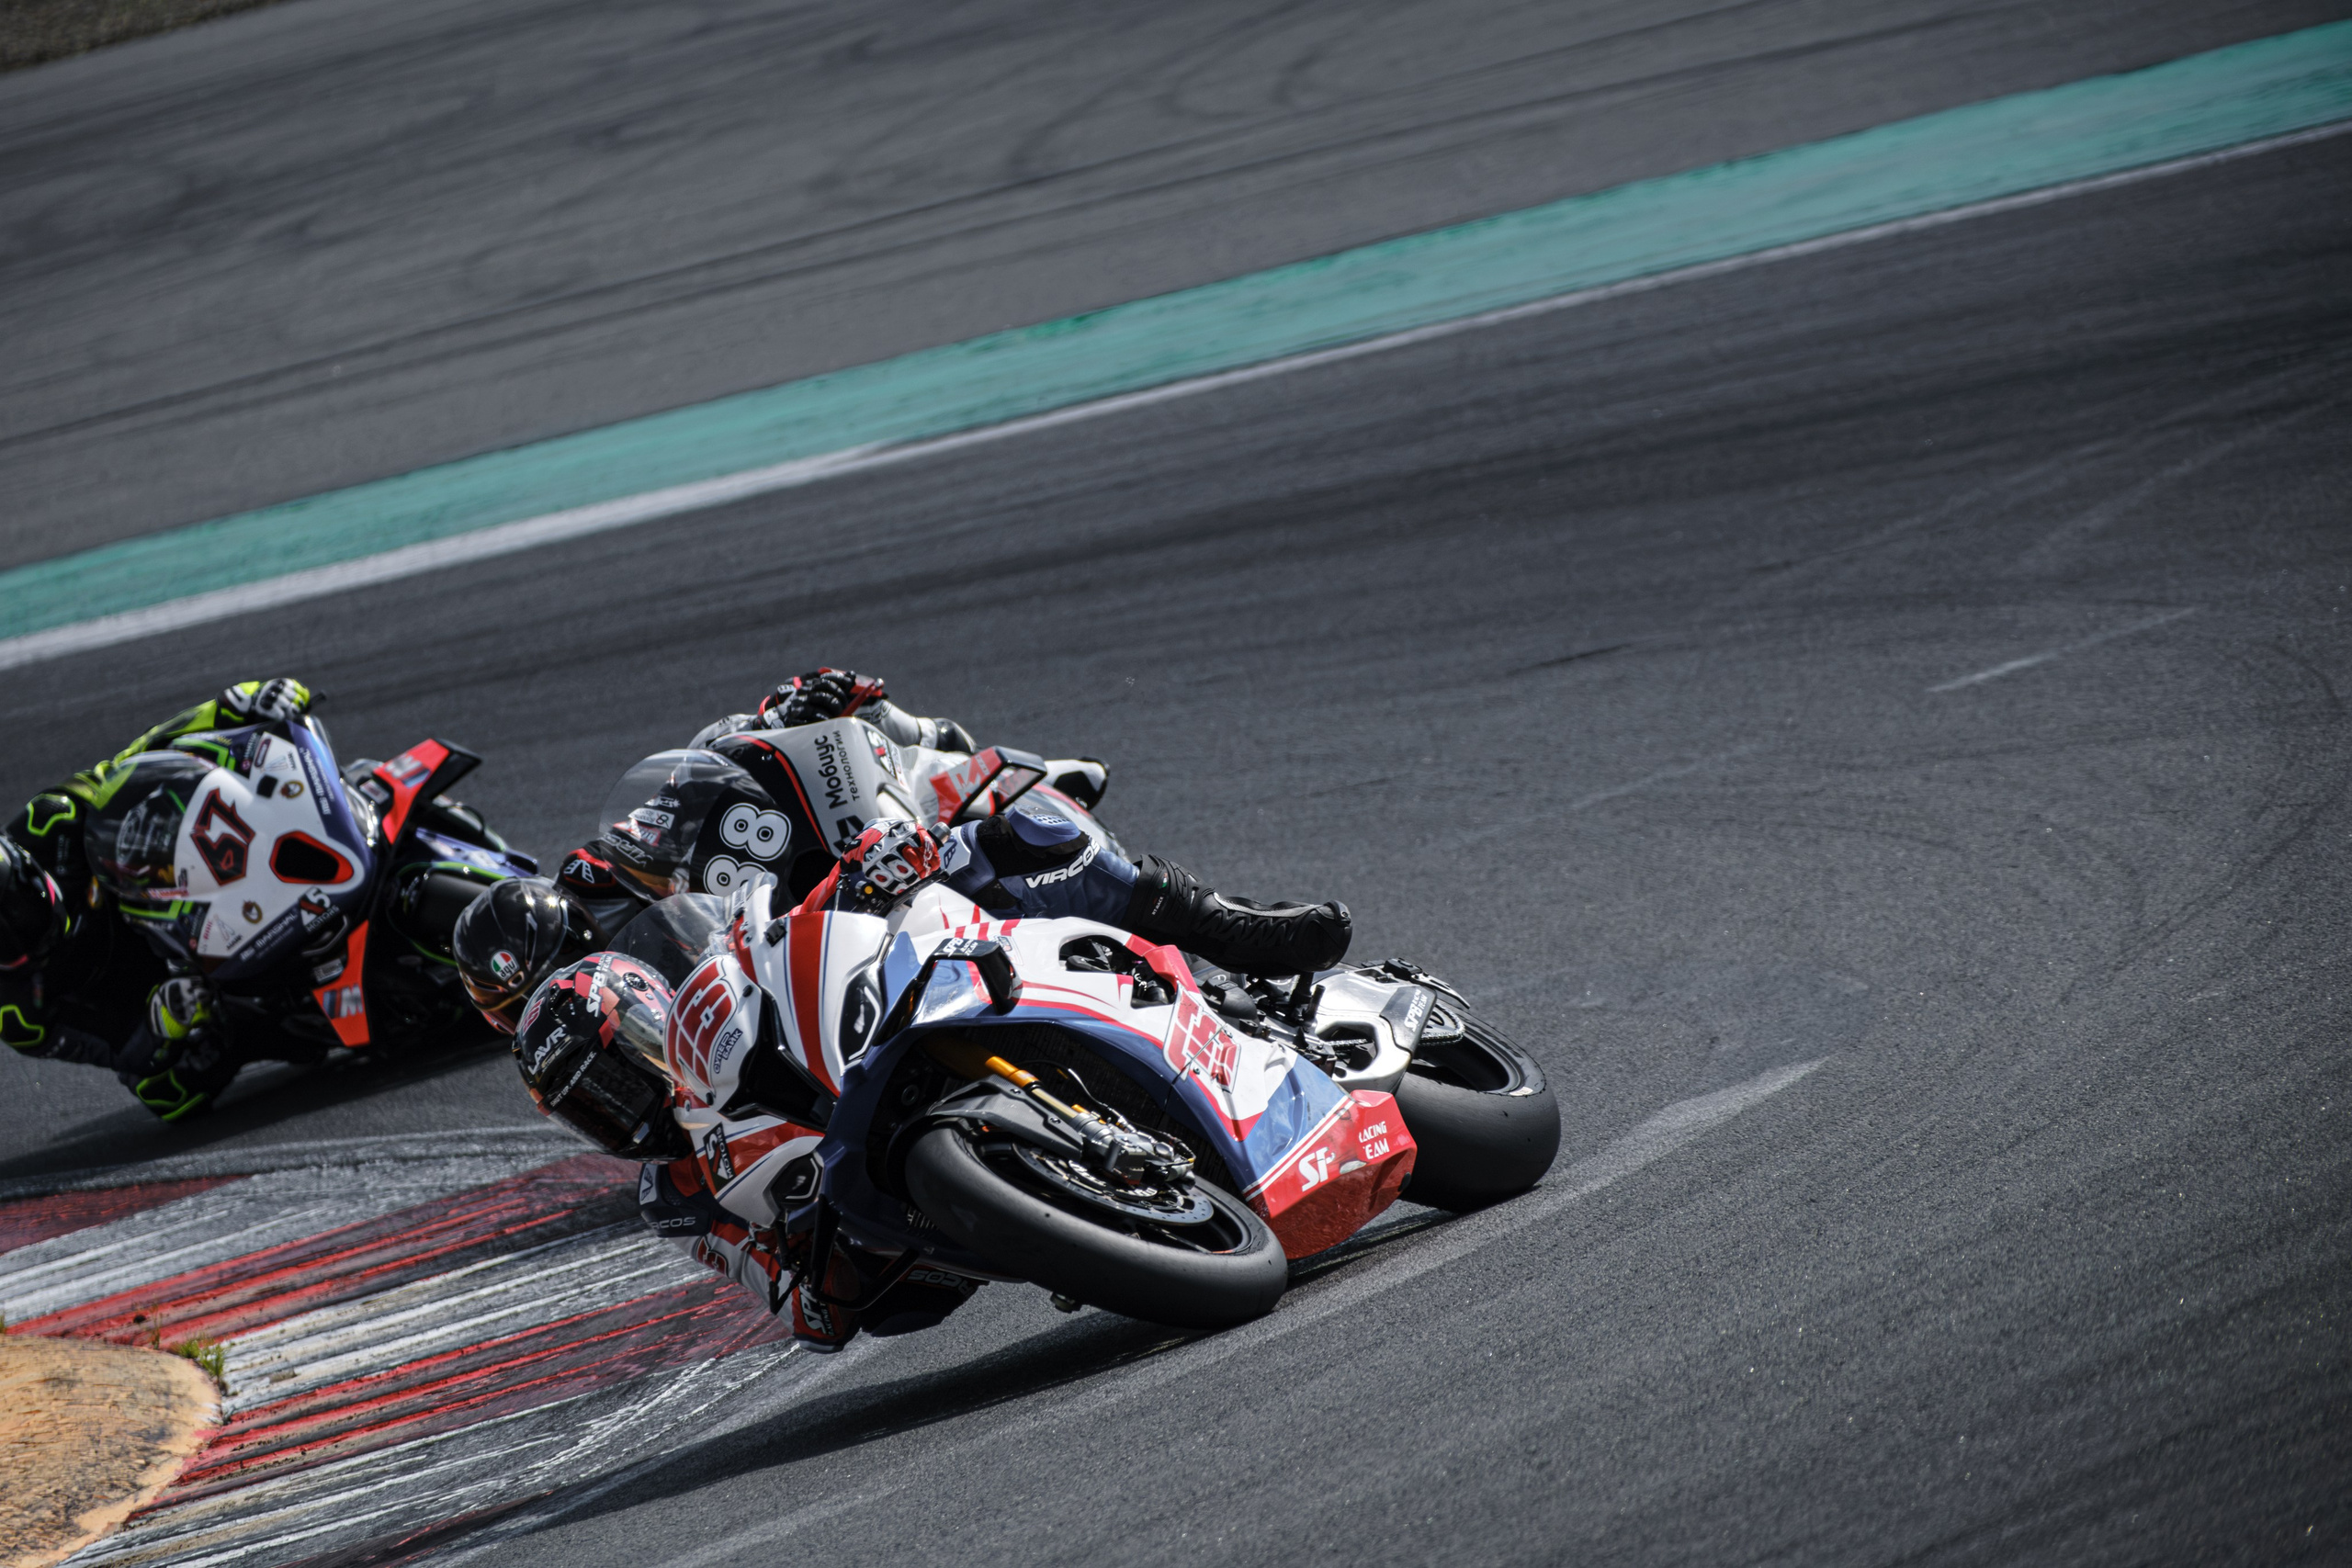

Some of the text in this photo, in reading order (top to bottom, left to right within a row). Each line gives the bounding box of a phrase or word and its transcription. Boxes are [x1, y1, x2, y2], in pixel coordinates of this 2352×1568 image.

[814, 734, 848, 810] Мобиус
[832, 729, 861, 802] технологии
[703, 802, 792, 897] 88
[1025, 837, 1102, 889] VIRCOS
[586, 971, 609, 1017] SPB
[1418, 994, 1428, 1010] TEAM
[1403, 1003, 1423, 1032] SPB
[527, 1026, 566, 1076] LAVR
[714, 1032, 731, 1074] СУПЕР
[723, 1028, 743, 1060] БАЙК
[570, 1070, 582, 1086] AND
[716, 1126, 734, 1180] MOTORS
[1363, 1138, 1390, 1160] EAM
